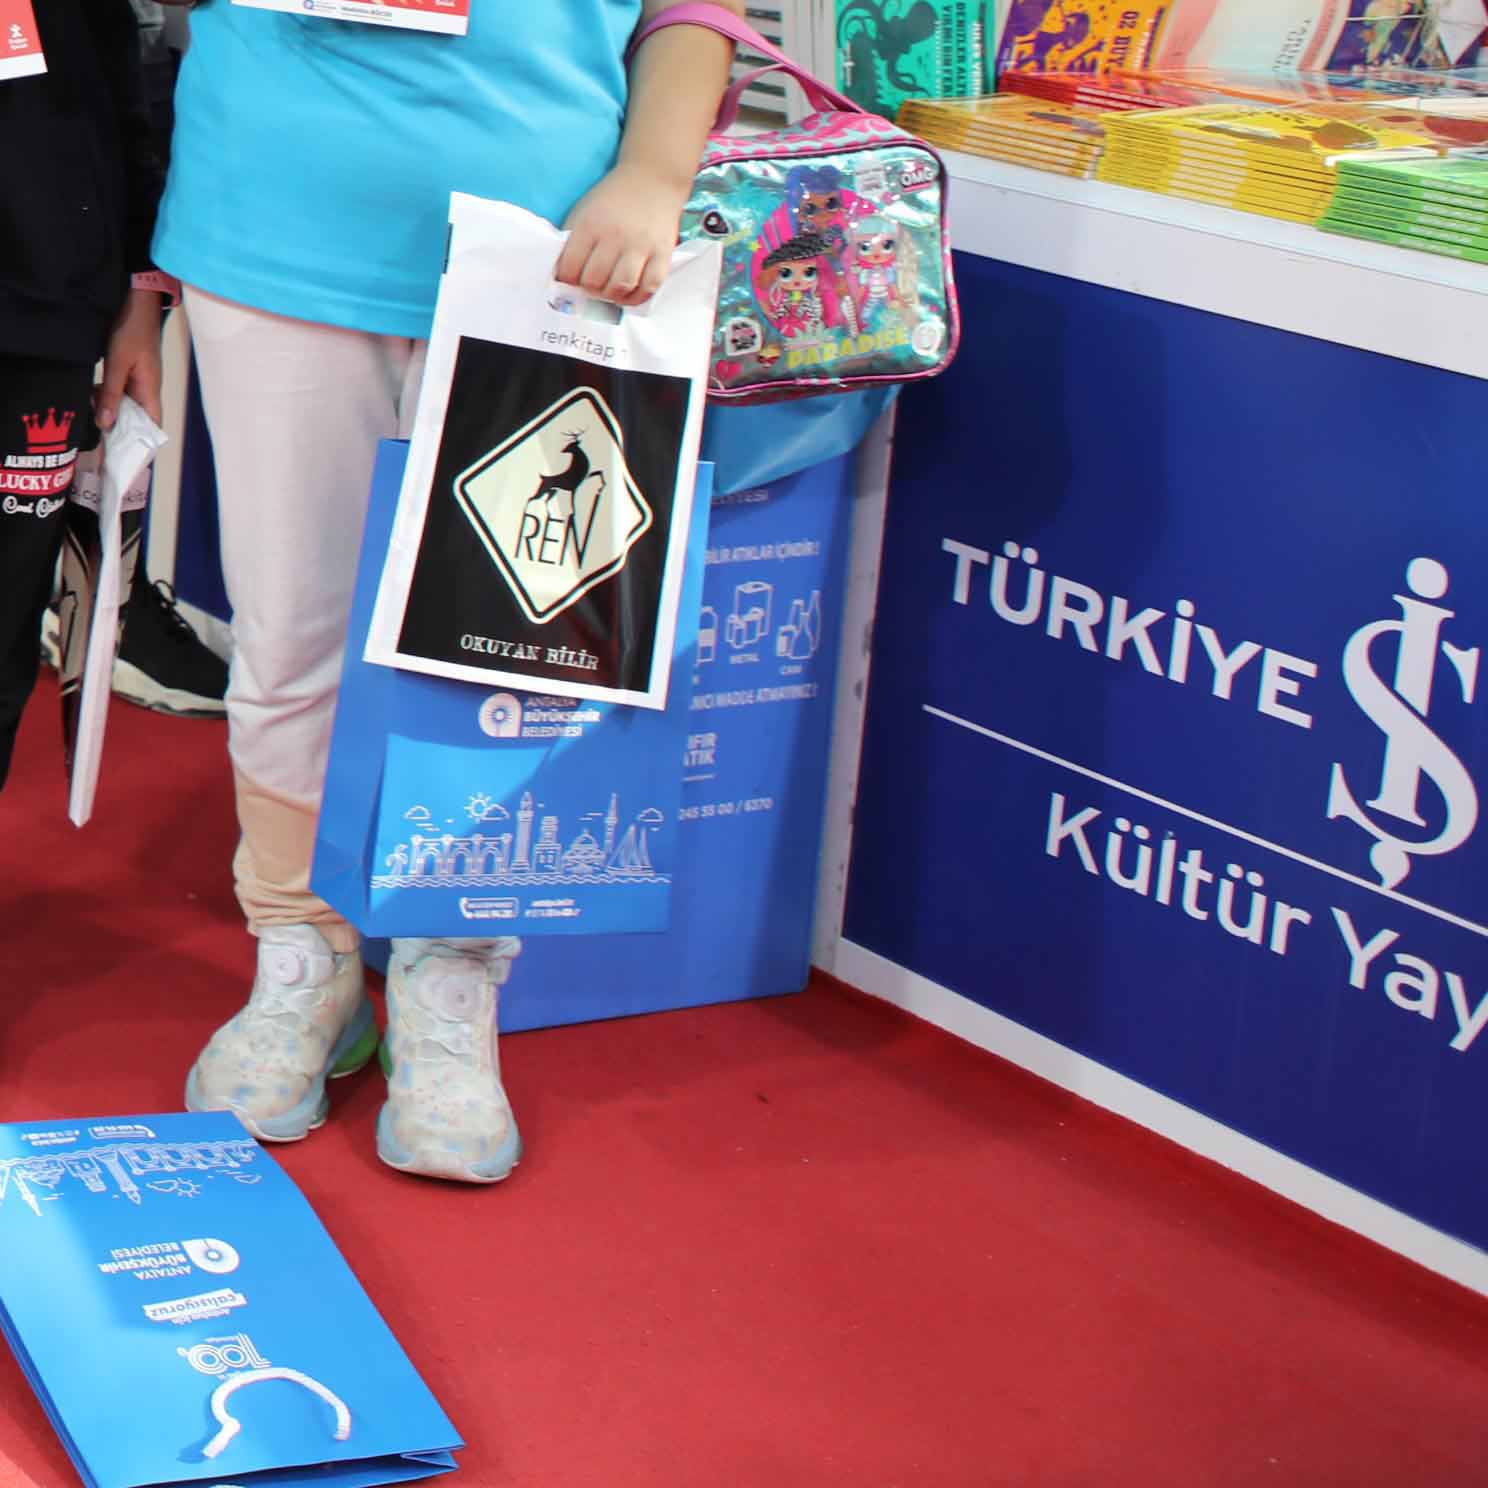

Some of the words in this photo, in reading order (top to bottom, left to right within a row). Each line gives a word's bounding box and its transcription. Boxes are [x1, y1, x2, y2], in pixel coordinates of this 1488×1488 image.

[540, 327, 616, 362] renkitap
[514, 492, 603, 570] REN
[460, 633, 542, 662] OKUYAN
[547, 645, 599, 671] BİLİR
[941, 537, 1318, 729] TÜRKİYE
[1044, 791, 1312, 955] Kültür
[133, 1265, 192, 1280] ANTALYA
